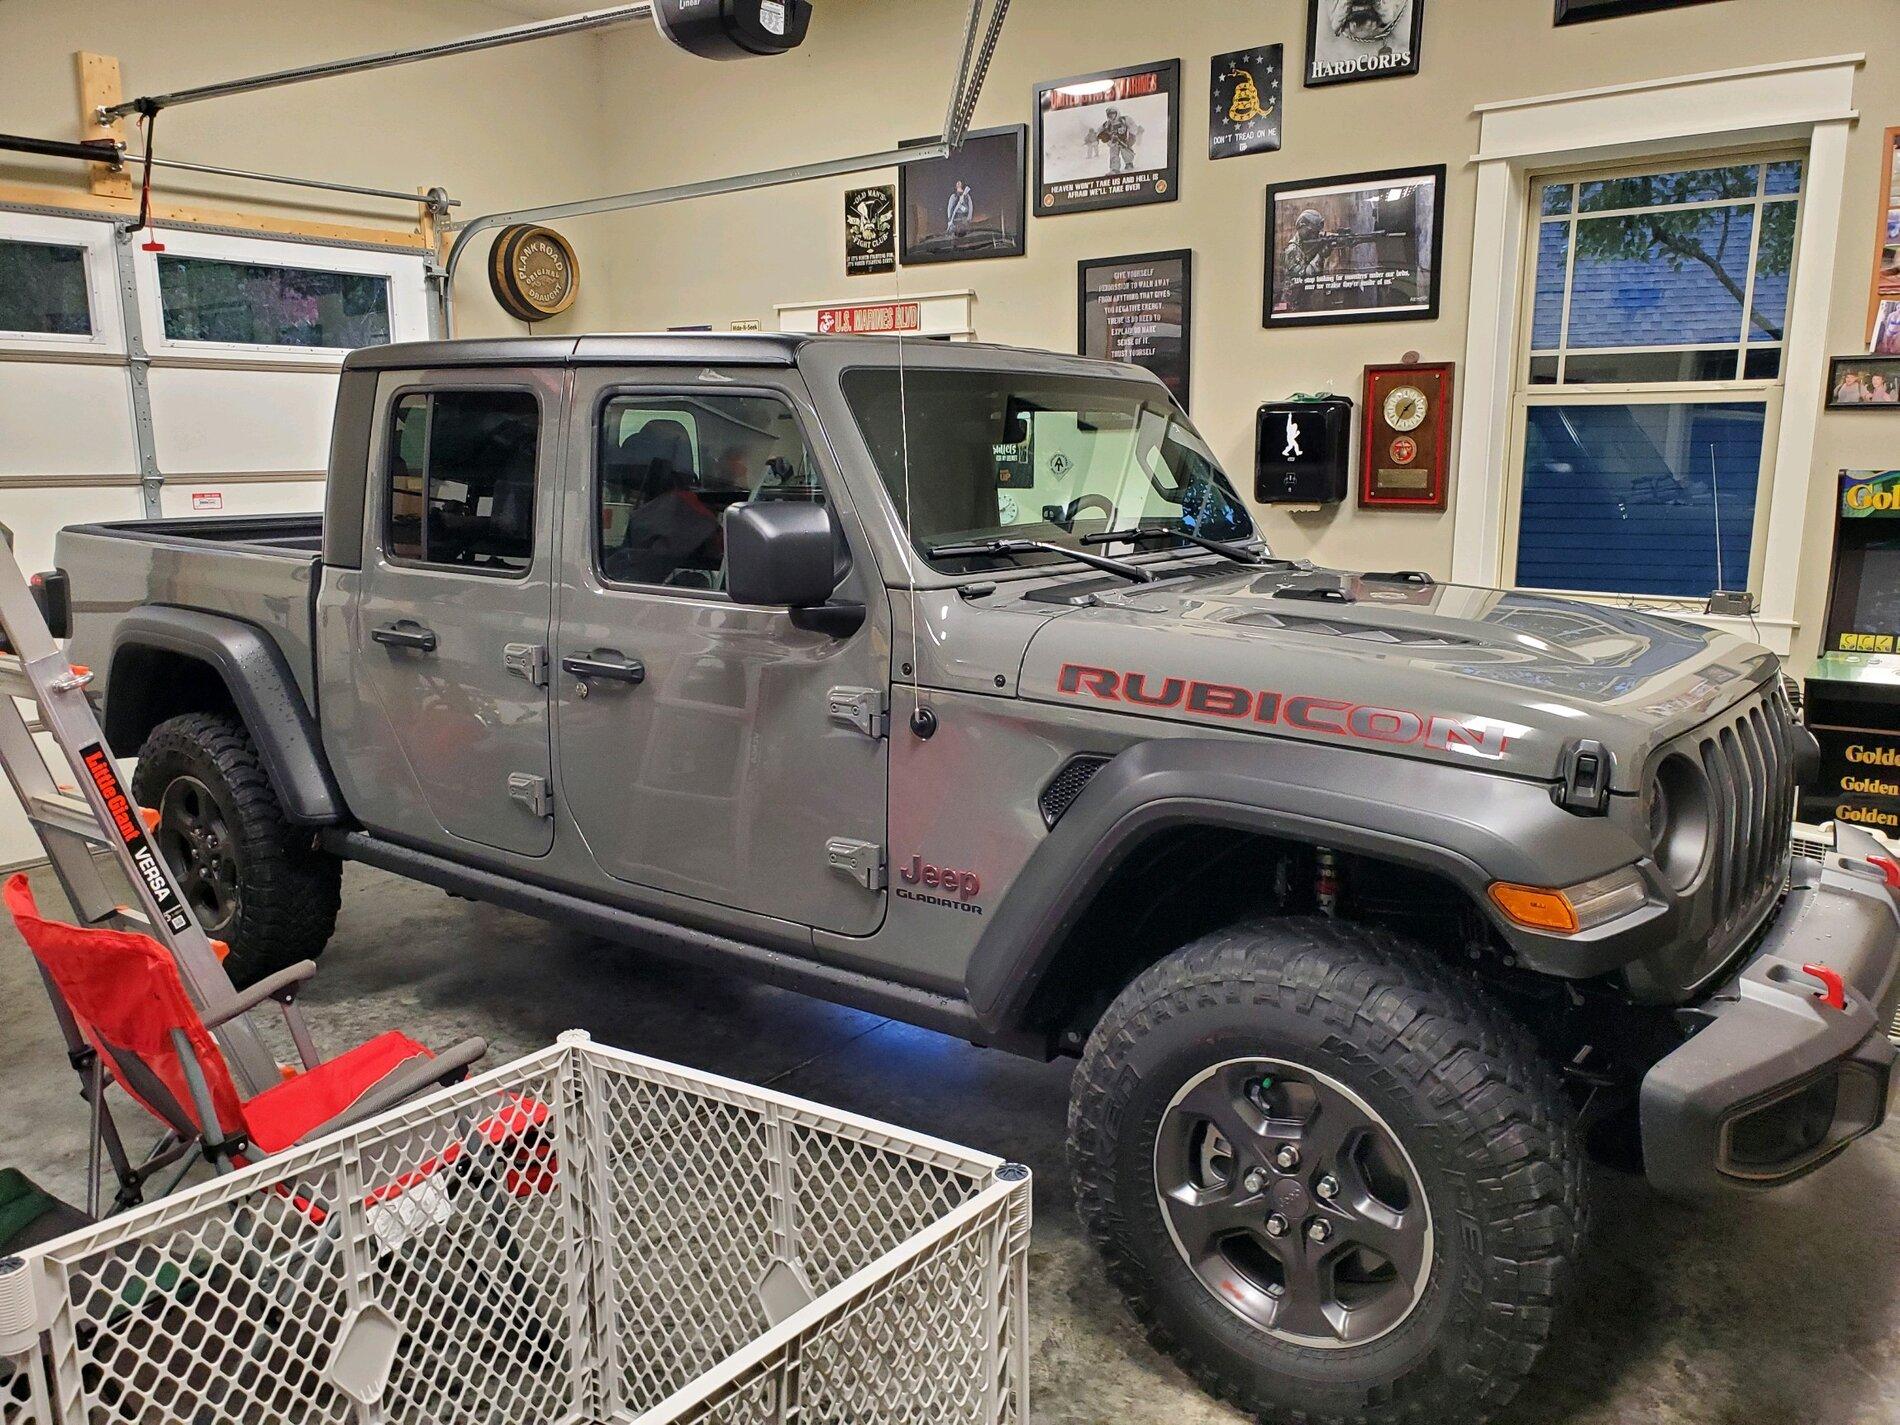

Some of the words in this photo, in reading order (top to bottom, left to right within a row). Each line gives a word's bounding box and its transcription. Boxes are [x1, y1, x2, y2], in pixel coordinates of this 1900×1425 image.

[1213, 134, 1232, 145] DON'T
[1235, 131, 1255, 142] TREAD
[1256, 129, 1266, 139] ON
[1267, 127, 1278, 137] ME
[1051, 184, 1074, 194] HEAVEN
[1096, 180, 1111, 189] TAKE
[1112, 178, 1121, 186] US
[1121, 176, 1135, 185] AND
[1136, 174, 1151, 183] HELL
[1152, 173, 1159, 181] IS
[1067, 190, 1088, 199] AFRAID
[1108, 185, 1124, 194] TAKE
[1125, 183, 1141, 192] OVER
[519, 243, 539, 280] PLANK
[539, 242, 563, 271] ROAD
[526, 268, 560, 285] ORIGINAL
[1113, 271, 1127, 280] GIVE
[1127, 268, 1154, 278] YOURSELF
[1131, 281, 1137, 289] TO
[1138, 280, 1153, 289] WALK
[1154, 278, 1170, 287] AWAY
[529, 282, 562, 302] DRAUGHT
[1098, 294, 1112, 303] FROM
[1112, 292, 1139, 302] ANYTHING
[1140, 291, 1154, 300] THAT
[1154, 289, 1171, 298] GIVES
[834, 310, 852, 333] U.S.
[853, 306, 894, 331] MARINES
[895, 305, 917, 329] BLVD
[1104, 306, 1115, 315] YOU
[1115, 304, 1141, 314] NEGATIVE
[1107, 316, 1124, 325] THERE
[1138, 314, 1153, 322] NEED
[1154, 313, 1161, 321] TO
[1117, 338, 1134, 346] SENSE
[1135, 337, 1142, 345] OF
[1111, 349, 1128, 358] TRUST
[1128, 347, 1156, 357] YOURSELF
[1057, 663, 1507, 759] RUBICON
[1840, 776, 1899, 796] Golden
[85, 750, 118, 799] Little
[107, 794, 141, 843] Giant
[1835, 804, 1898, 827] Golden
[134, 845, 171, 903] VERSA
[900, 854, 980, 902] Jeep
[896, 888, 983, 916] GLADIATOR
